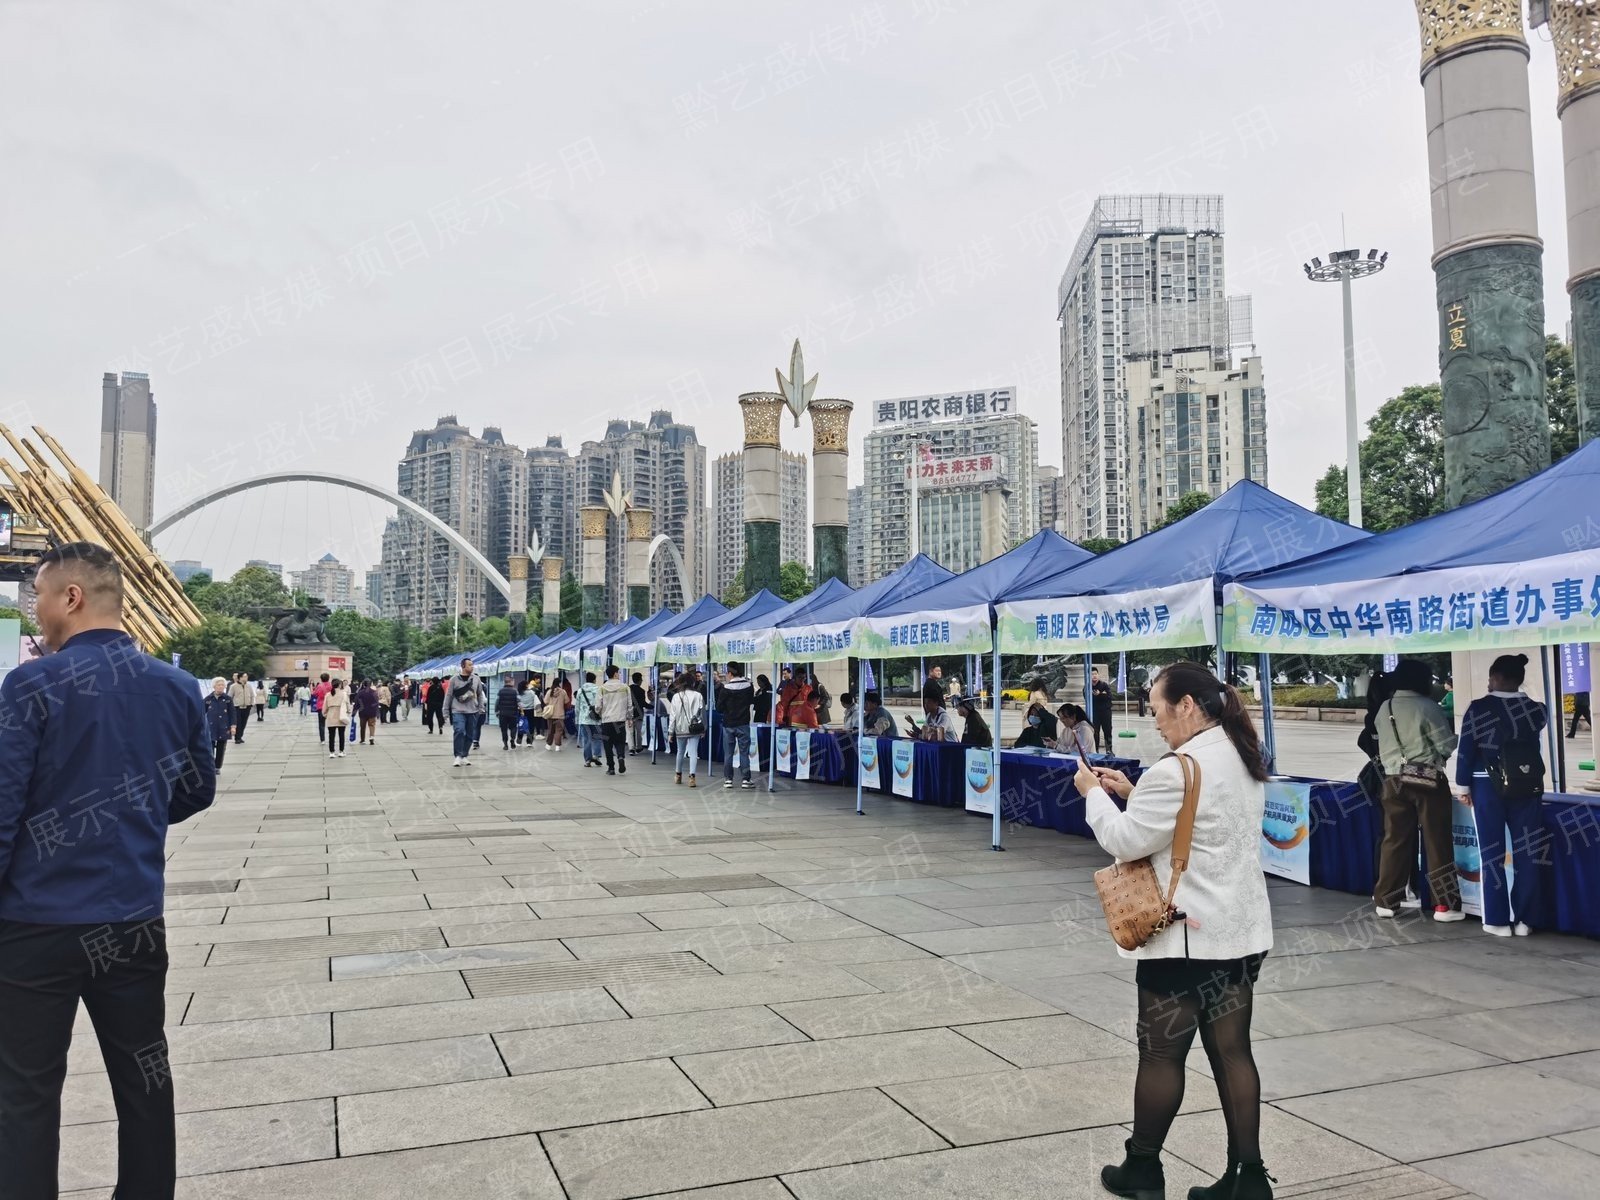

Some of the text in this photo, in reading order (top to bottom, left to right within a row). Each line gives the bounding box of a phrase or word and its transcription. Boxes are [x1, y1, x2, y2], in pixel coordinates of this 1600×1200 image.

[1447, 303, 1467, 350] 立夏
[877, 390, 1011, 422] 贵阳农商银行
[889, 620, 950, 647] 南明区民政局
[1035, 604, 1171, 640] 南明区农业农村局
